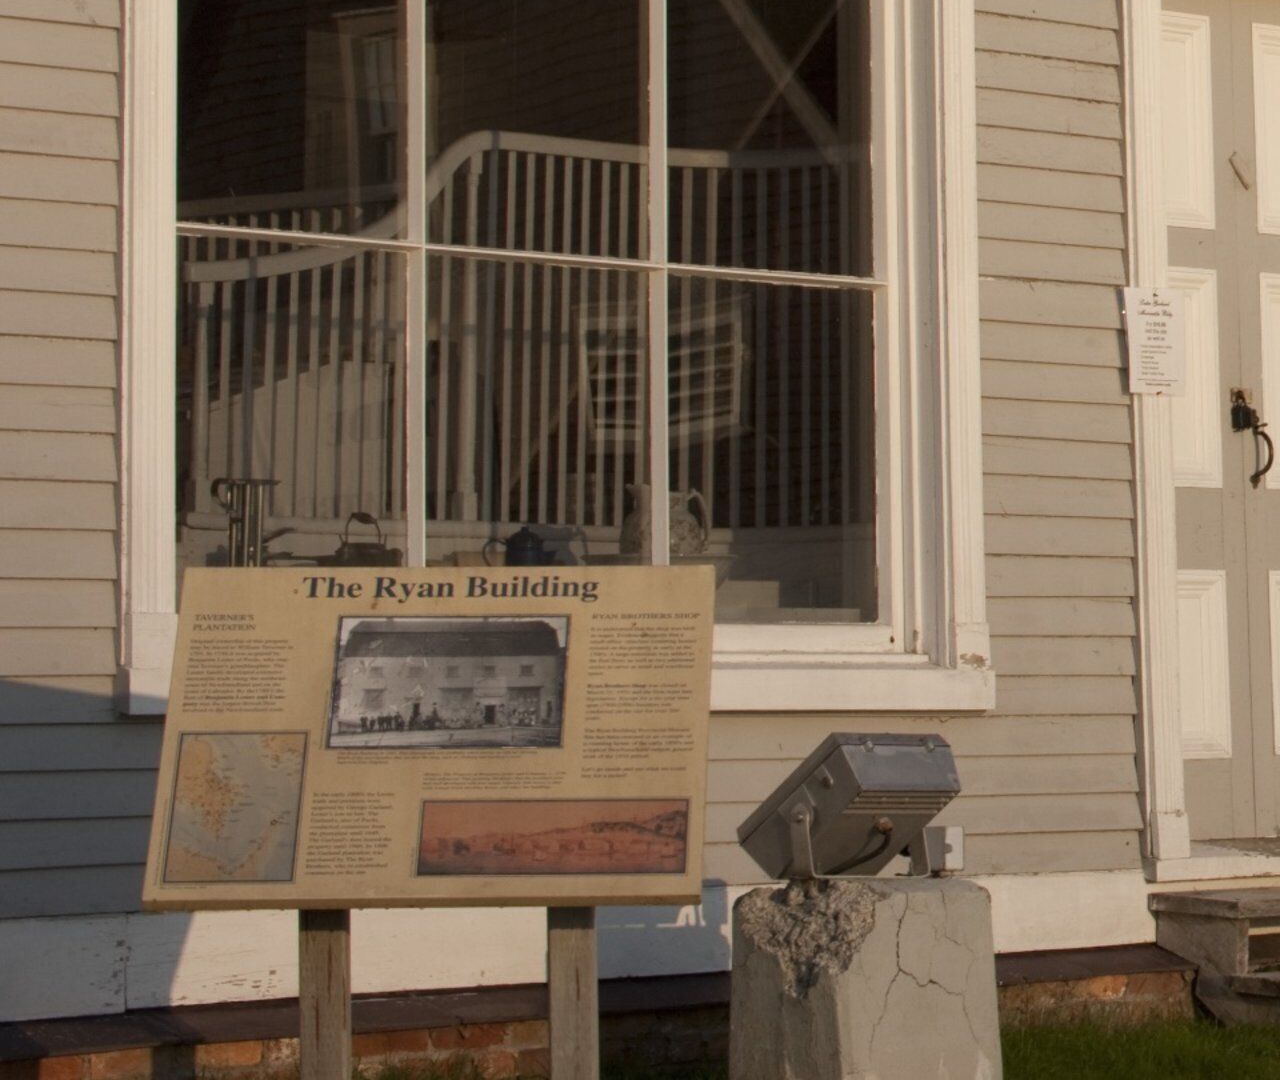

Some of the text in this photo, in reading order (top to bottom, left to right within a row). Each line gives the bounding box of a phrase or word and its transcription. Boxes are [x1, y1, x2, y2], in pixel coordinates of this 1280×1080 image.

[302, 575, 599, 603] The Ryan Building
[194, 614, 255, 622] TAVERNER'S
[193, 623, 257, 632] PLANTATION
